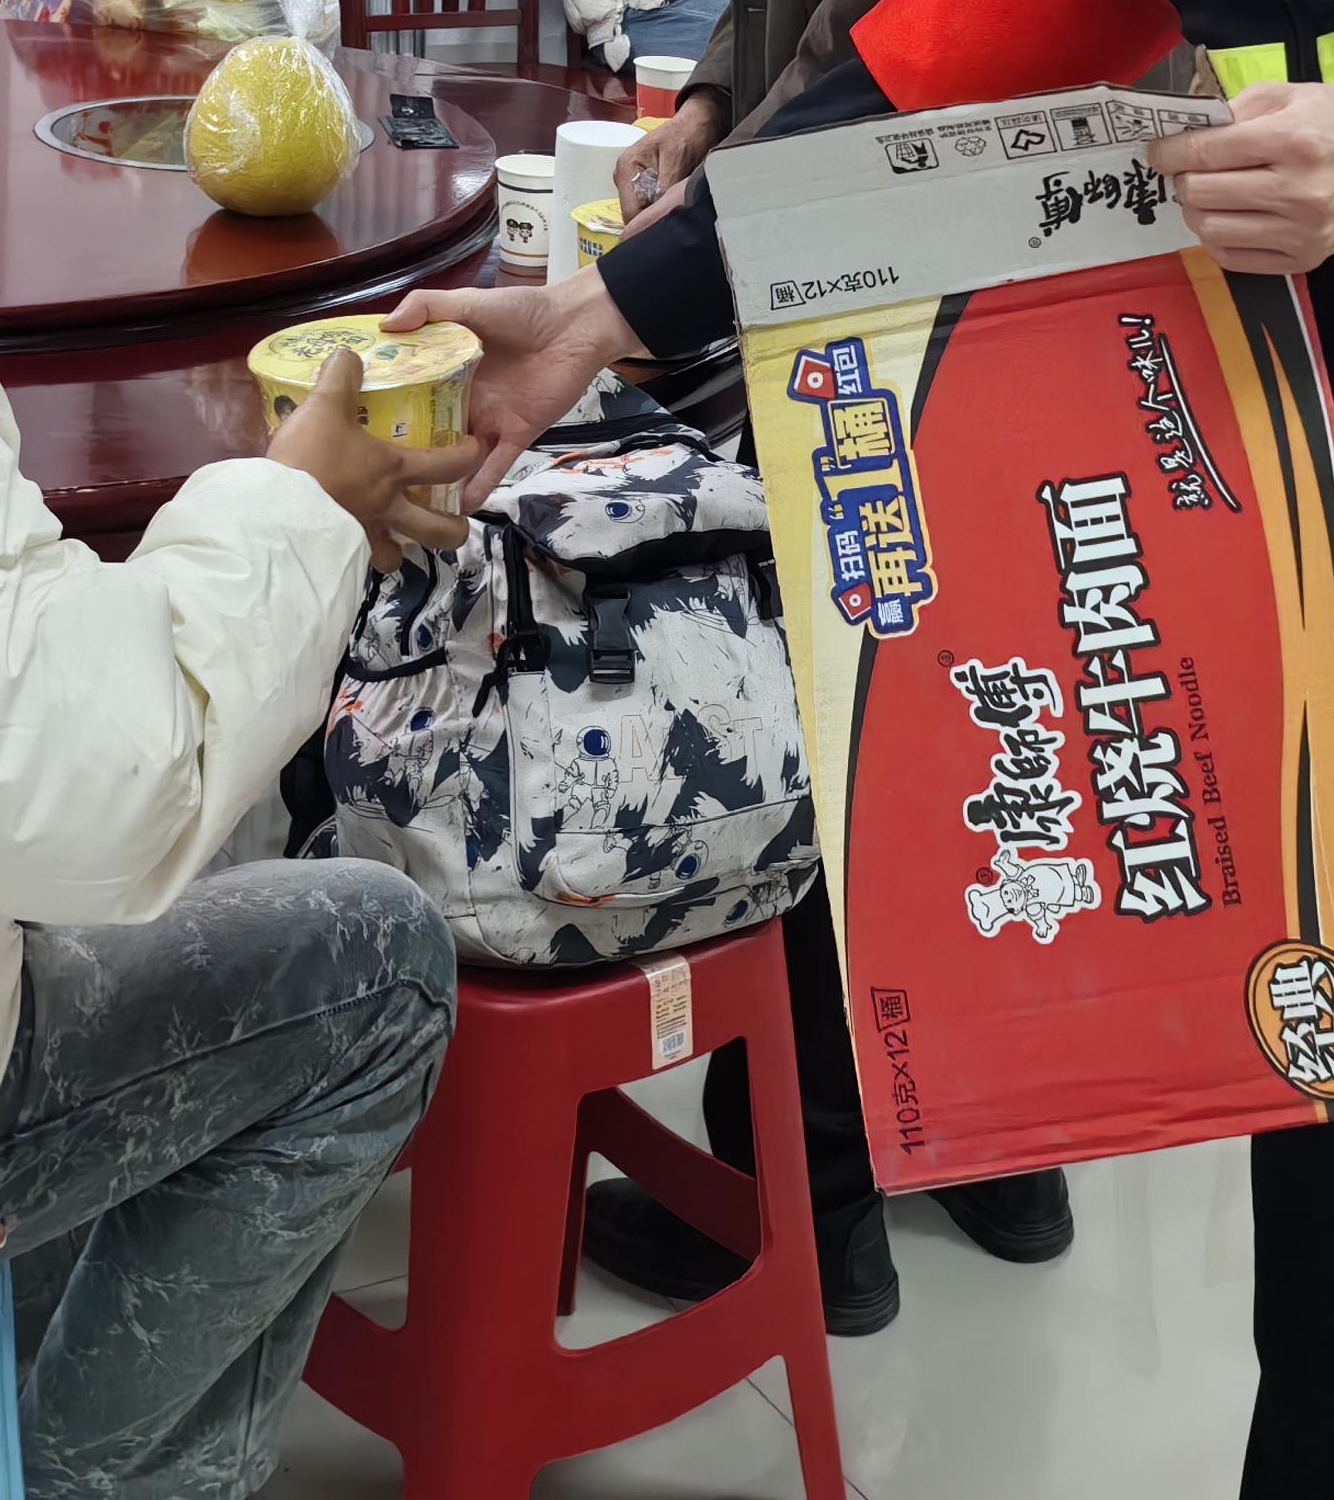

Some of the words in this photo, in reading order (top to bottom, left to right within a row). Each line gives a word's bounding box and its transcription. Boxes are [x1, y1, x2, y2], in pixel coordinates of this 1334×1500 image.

[832, 344, 863, 395] 红包
[834, 529, 866, 581] 扫码
[877, 598, 905, 626] 赢
[1040, 474, 1208, 920] 红烧牛肉面
[1178, 656, 1210, 743] Noodle
[1194, 751, 1222, 806] Beef
[1208, 815, 1242, 908] Braised
